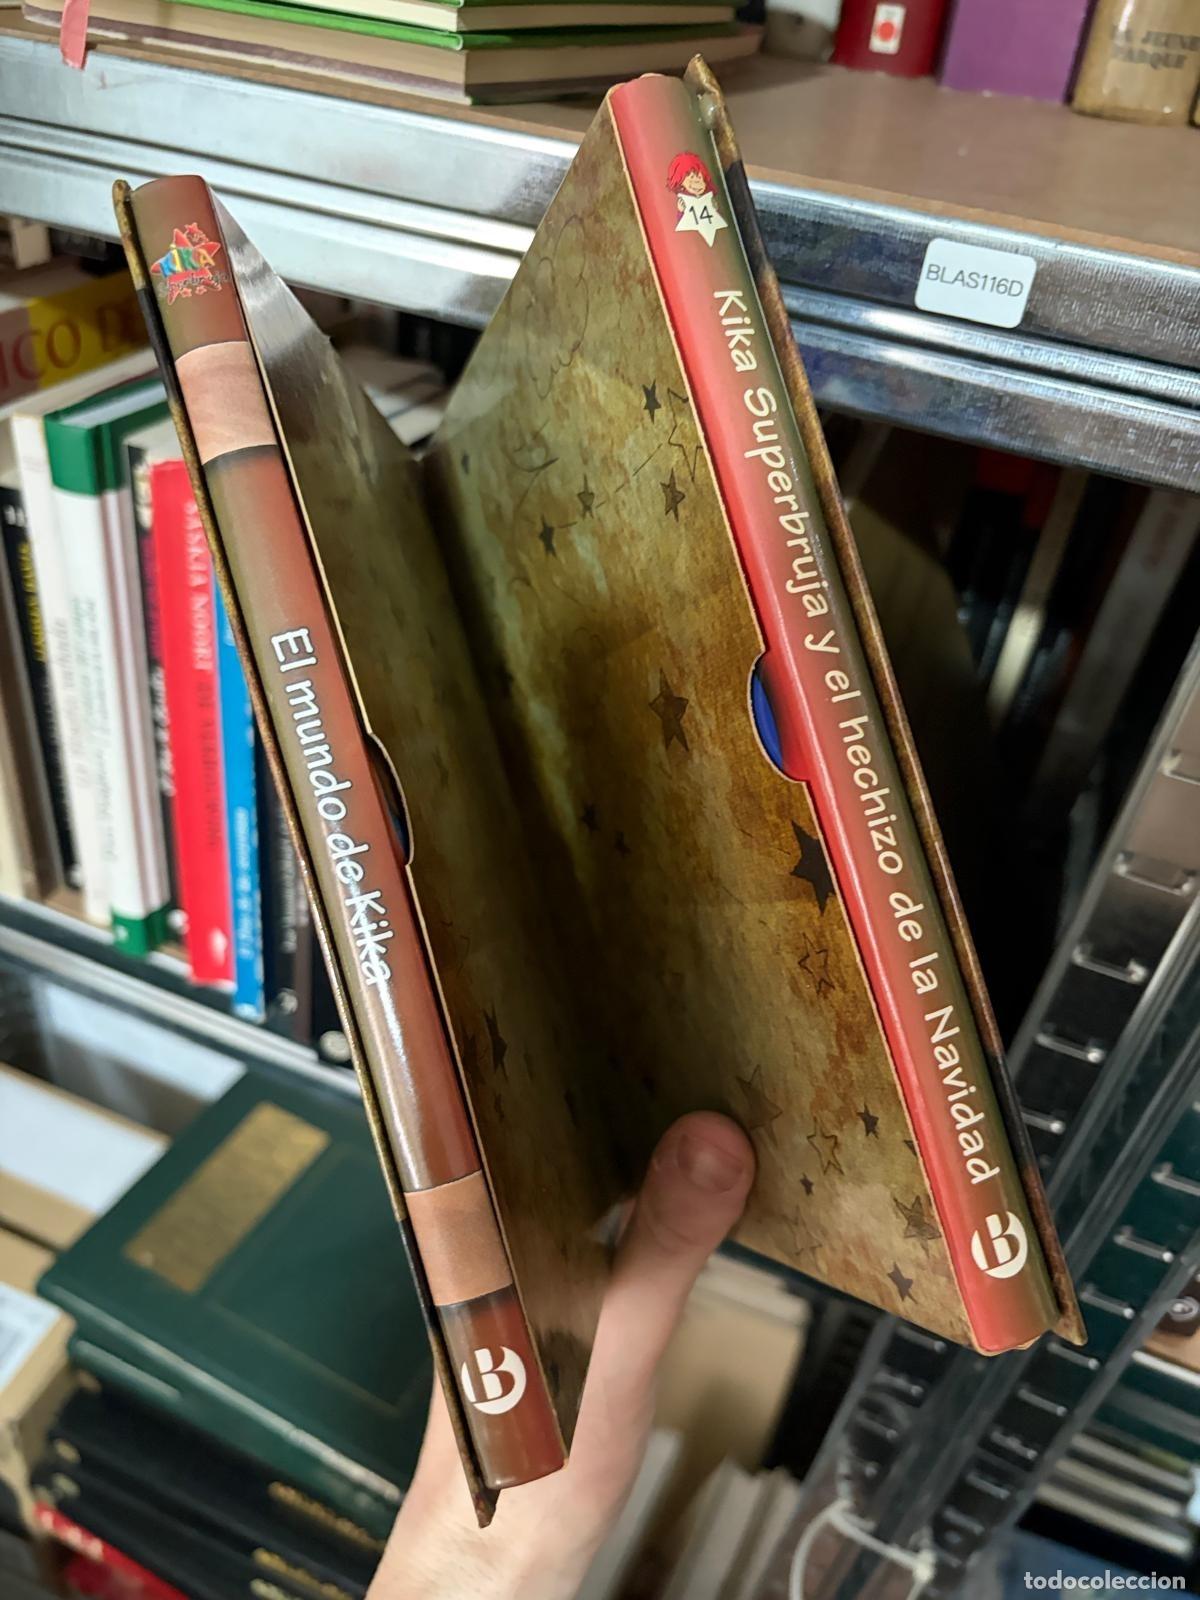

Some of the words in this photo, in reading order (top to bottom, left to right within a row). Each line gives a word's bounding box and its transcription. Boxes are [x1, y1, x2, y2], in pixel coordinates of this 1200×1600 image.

[689, 205, 713, 225] 14
[925, 263, 1025, 297] BLAS116D
[713, 290, 758, 372] Kika
[743, 387, 829, 618] Superbruja
[270, 628, 317, 673] El
[804, 630, 841, 654] y
[824, 669, 862, 703] el
[285, 679, 353, 822] mundo
[838, 715, 903, 874] hechizo
[326, 833, 370, 884] de
[345, 890, 395, 986] Kika
[888, 892, 925, 942] de
[908, 951, 939, 995] la
[924, 1005, 1000, 1185] Navidad
